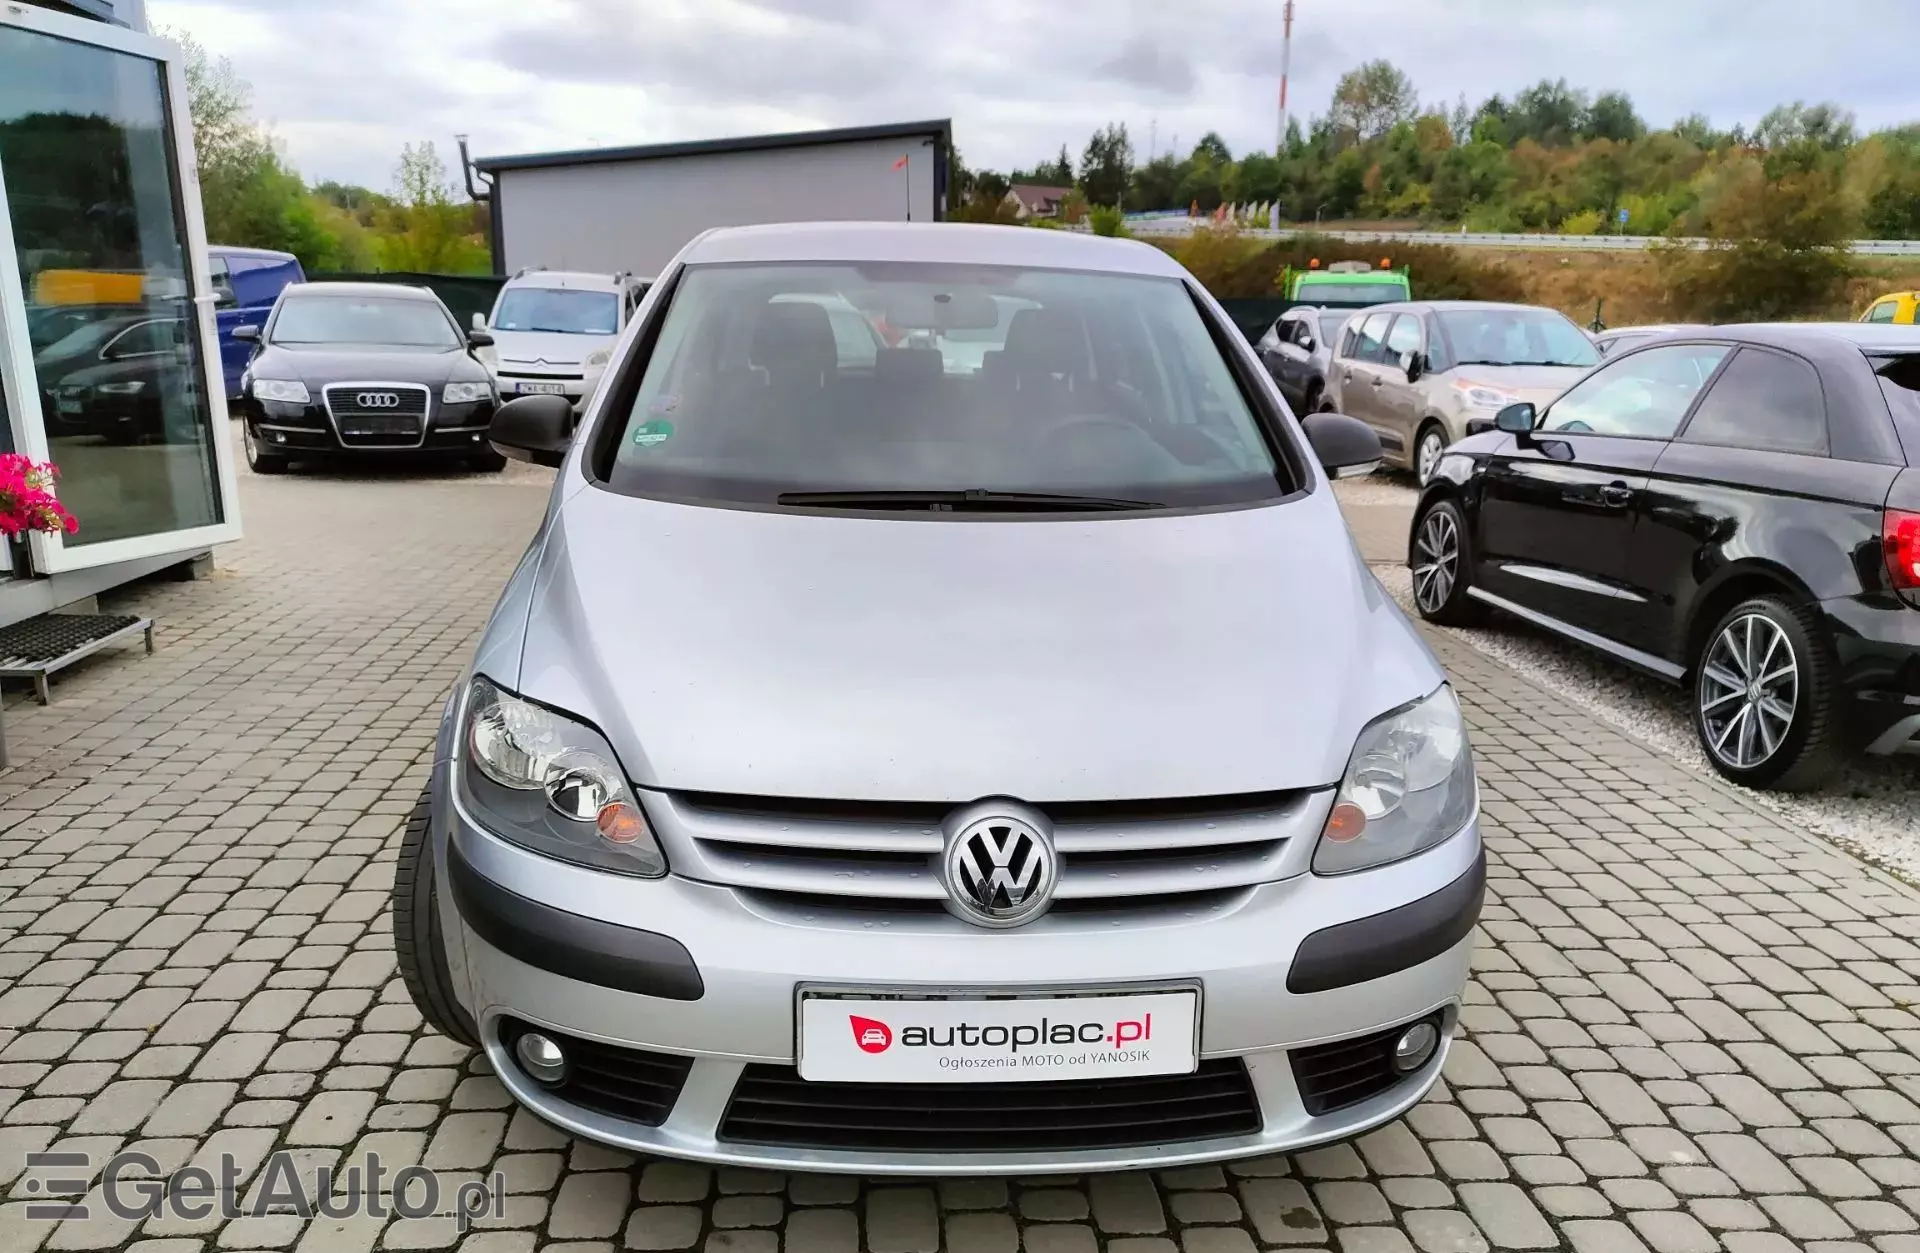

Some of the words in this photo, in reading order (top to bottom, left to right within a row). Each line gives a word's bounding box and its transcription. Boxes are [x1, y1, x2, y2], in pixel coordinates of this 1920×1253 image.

[901, 1013, 1151, 1052] autoplac.pl
[938, 1055, 1018, 1071] Ogłoszenia
[1022, 1054, 1064, 1067] MOTO
[1068, 1053, 1086, 1065] od
[1090, 1050, 1150, 1064] YANOSIK
